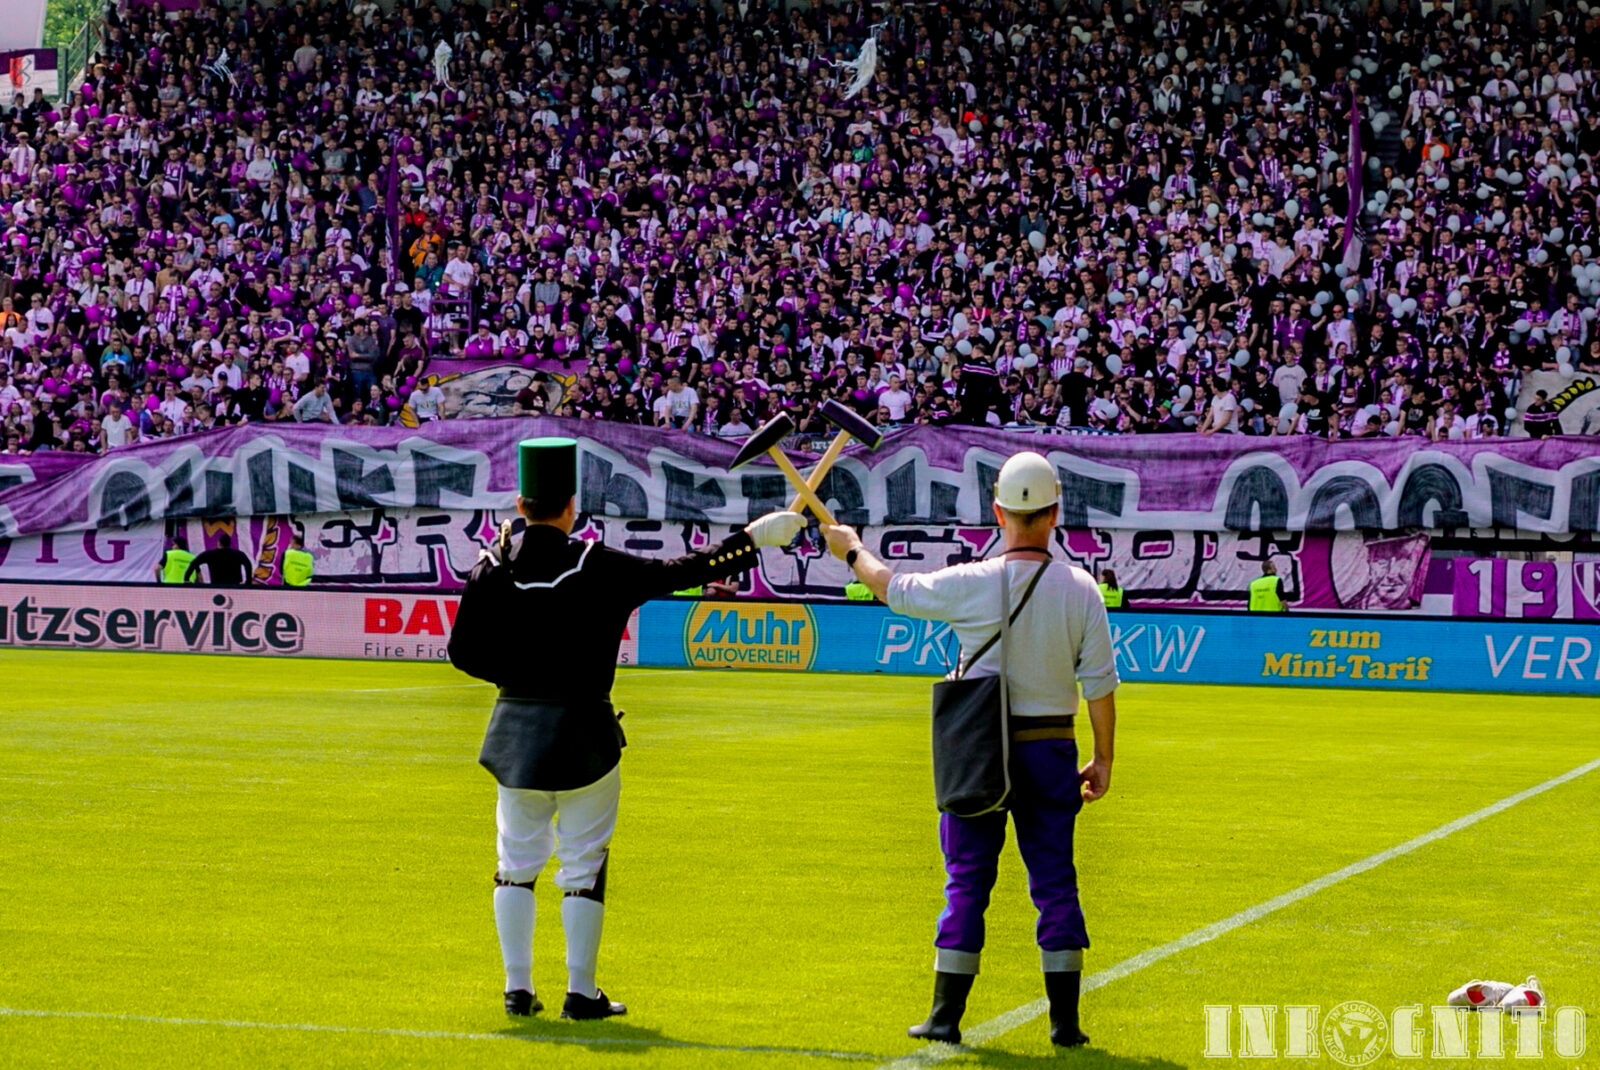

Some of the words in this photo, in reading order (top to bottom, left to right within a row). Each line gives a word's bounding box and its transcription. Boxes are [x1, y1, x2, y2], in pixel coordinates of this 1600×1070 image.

[0, 594, 304, 655] tzservice
[693, 609, 806, 647] Muhr
[875, 616, 953, 667] PK
[1309, 629, 1381, 649] zum
[364, 642, 405, 658] Fire
[416, 643, 448, 662] Fig
[694, 647, 800, 664] AUTOVERLEIH
[1108, 623, 1206, 673] KW
[1261, 652, 1433, 681] Mini-Tarif
[1484, 635, 1600, 680] VER
